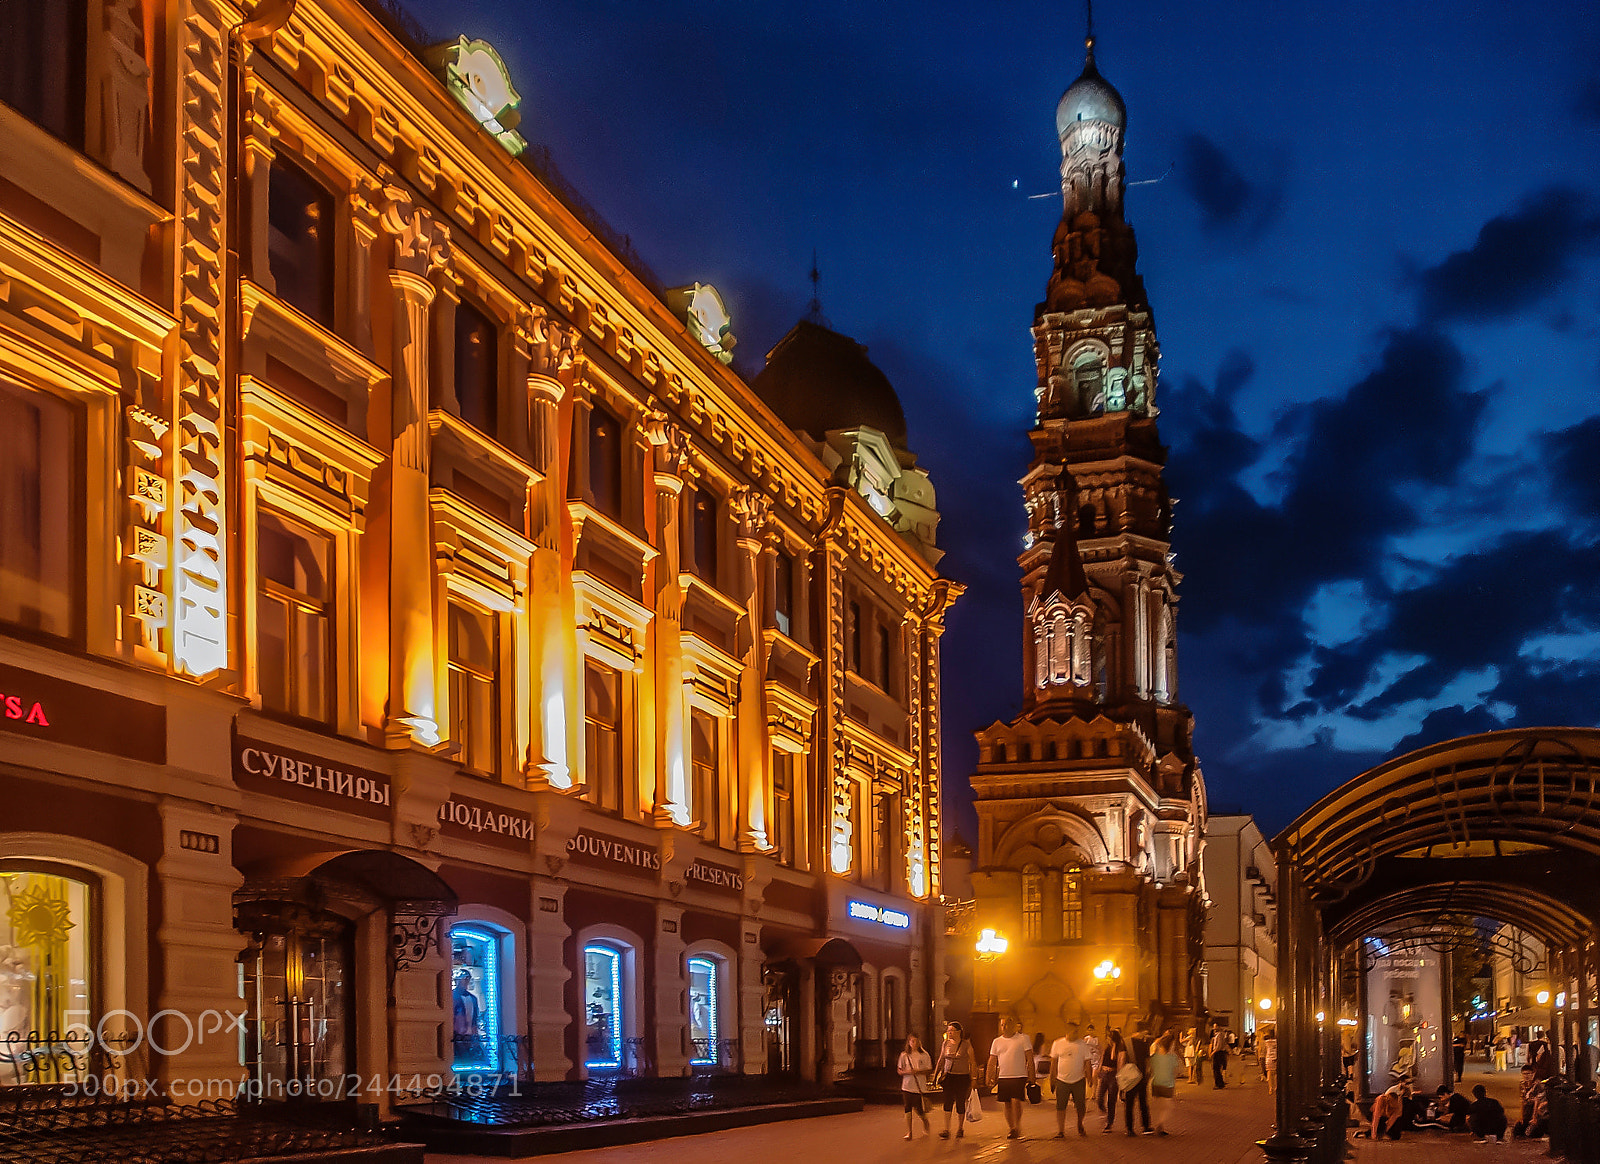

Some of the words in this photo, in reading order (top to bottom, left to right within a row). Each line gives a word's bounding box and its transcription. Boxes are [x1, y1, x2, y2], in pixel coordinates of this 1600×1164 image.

[0, 693, 50, 727] SA
[241, 748, 390, 806] СУВЕНИРЫ
[440, 800, 535, 841] ПОДАРКИ
[567, 834, 660, 870] SOUVENIRS
